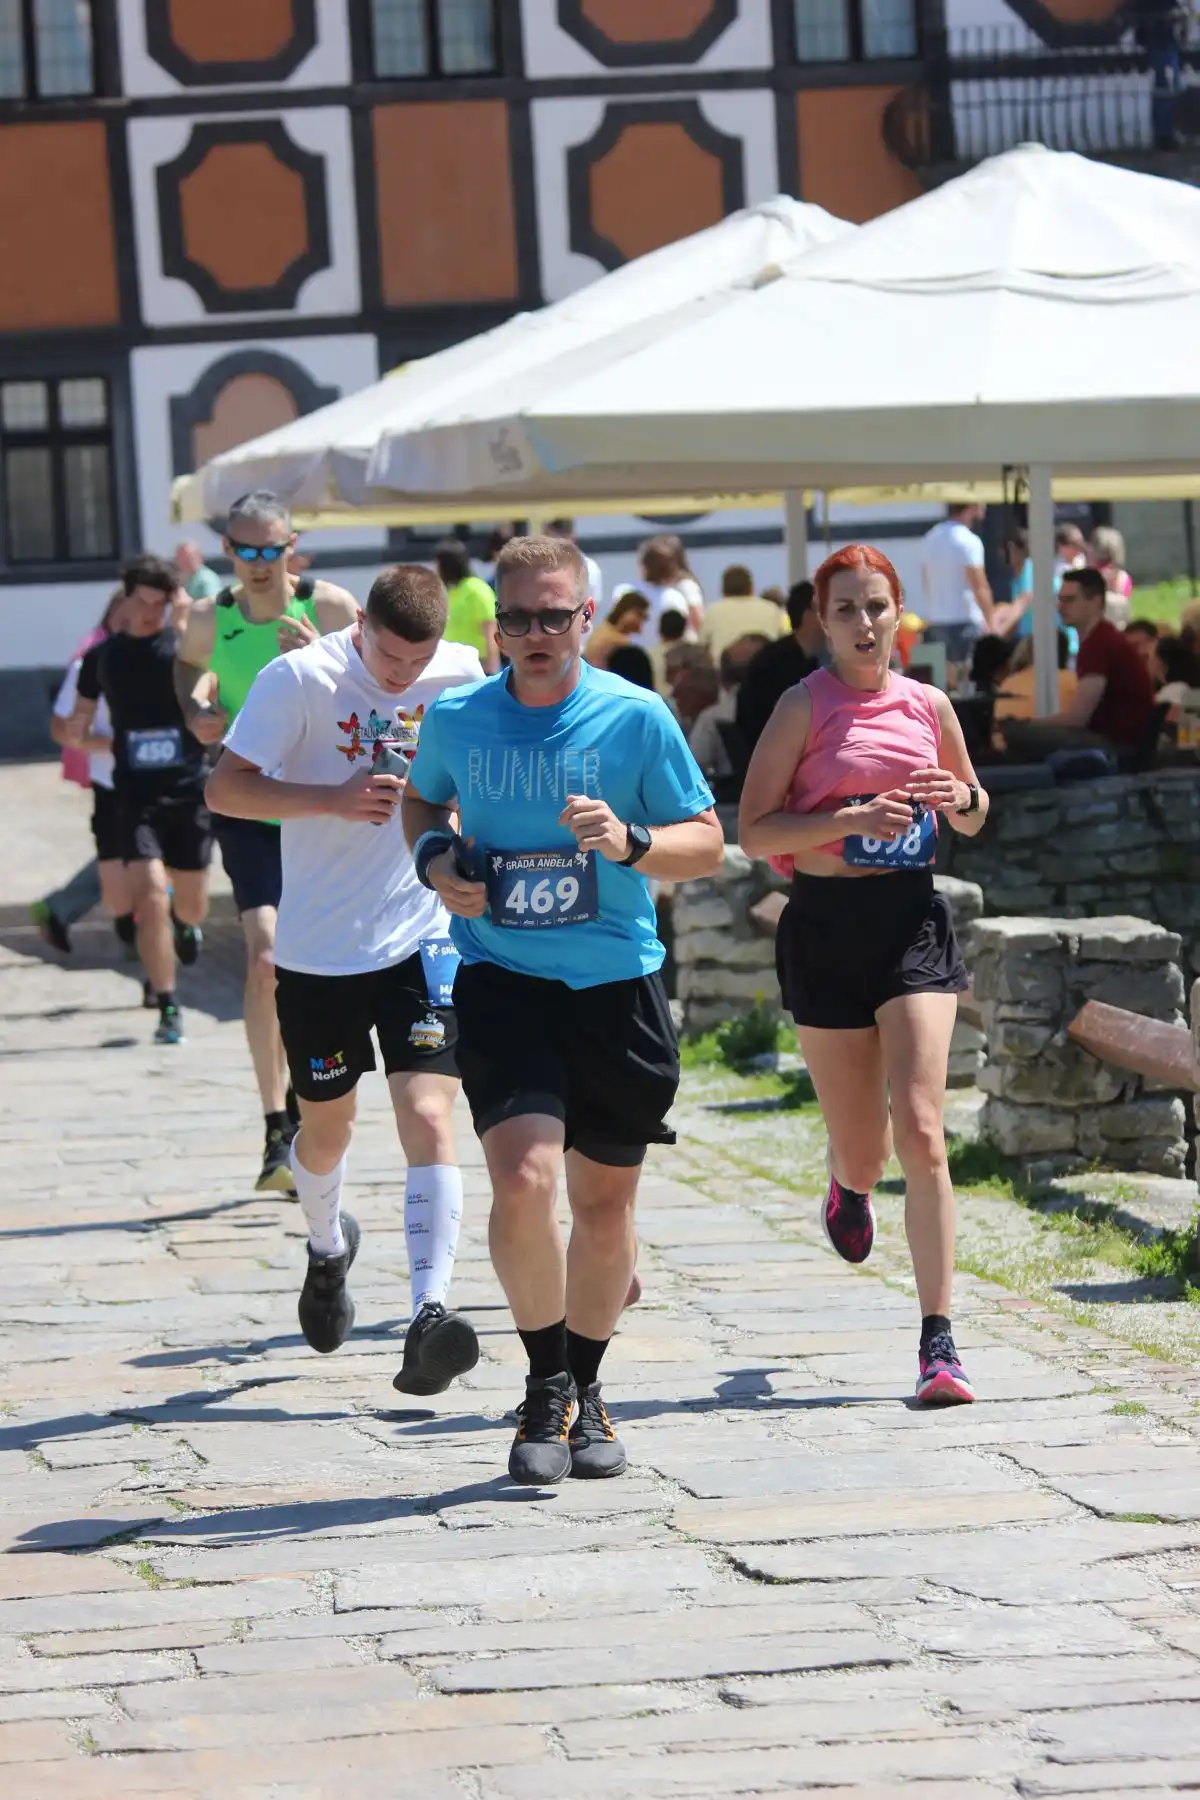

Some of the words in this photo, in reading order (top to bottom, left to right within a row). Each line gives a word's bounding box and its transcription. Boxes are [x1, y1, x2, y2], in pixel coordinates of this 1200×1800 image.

[468, 746, 602, 803] RUNNER
[506, 859, 535, 871] GRADA
[537, 858, 573, 868] ANĐELA
[505, 876, 580, 914] 469
